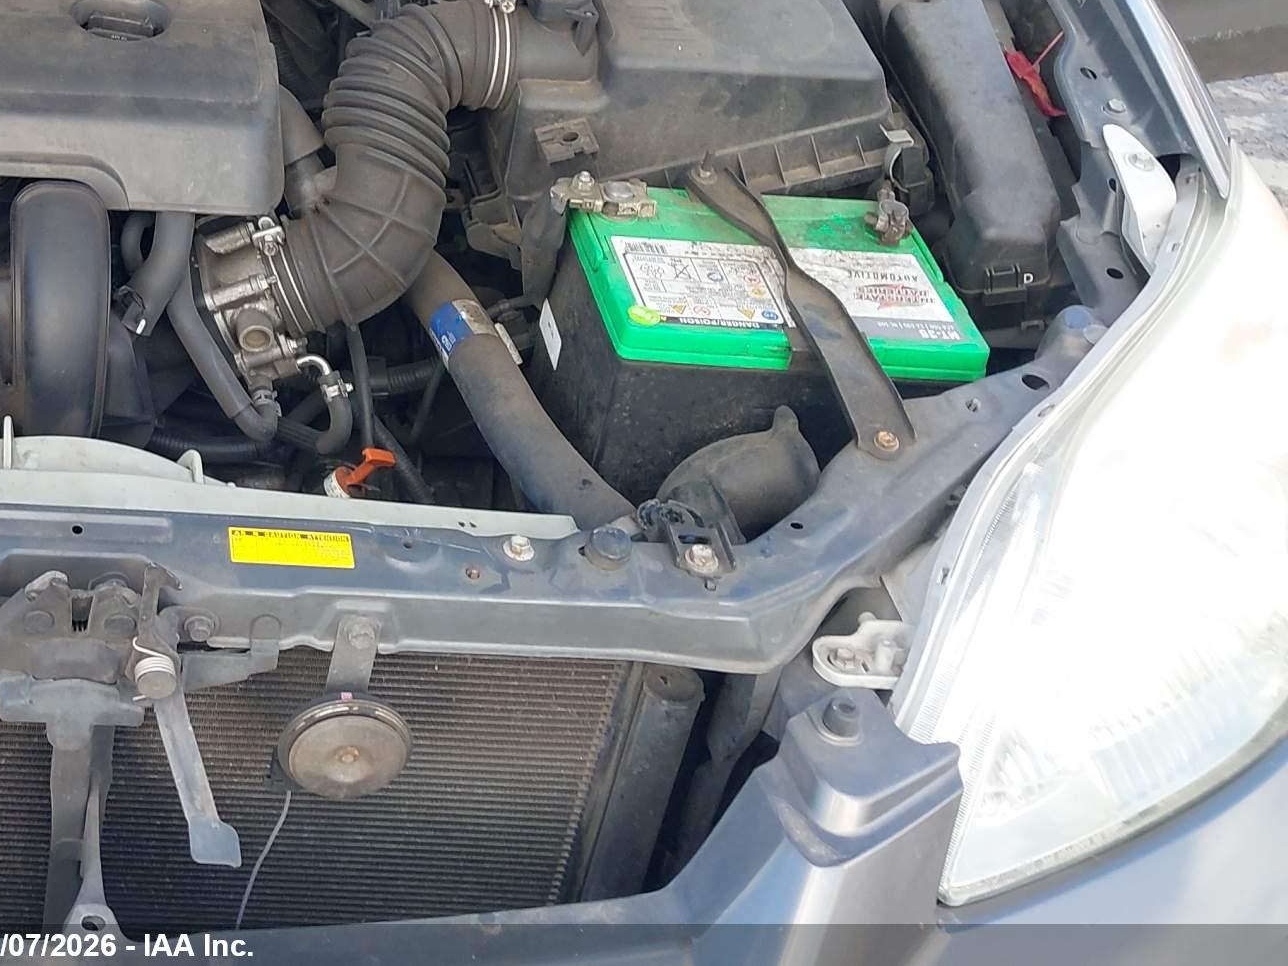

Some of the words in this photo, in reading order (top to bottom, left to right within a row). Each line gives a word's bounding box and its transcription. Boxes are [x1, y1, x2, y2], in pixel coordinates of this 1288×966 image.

[848, 270, 918, 282] AUTOMOTIVE
[1023, 272, 1034, 284] D
[856, 286, 928, 296] BATTERIES
[854, 293, 935, 304] INTERSTATE
[679, 317, 760, 329] DANGER/POISON
[266, 532, 301, 540] CAUTION
[308, 535, 350, 543] ATTENTION
